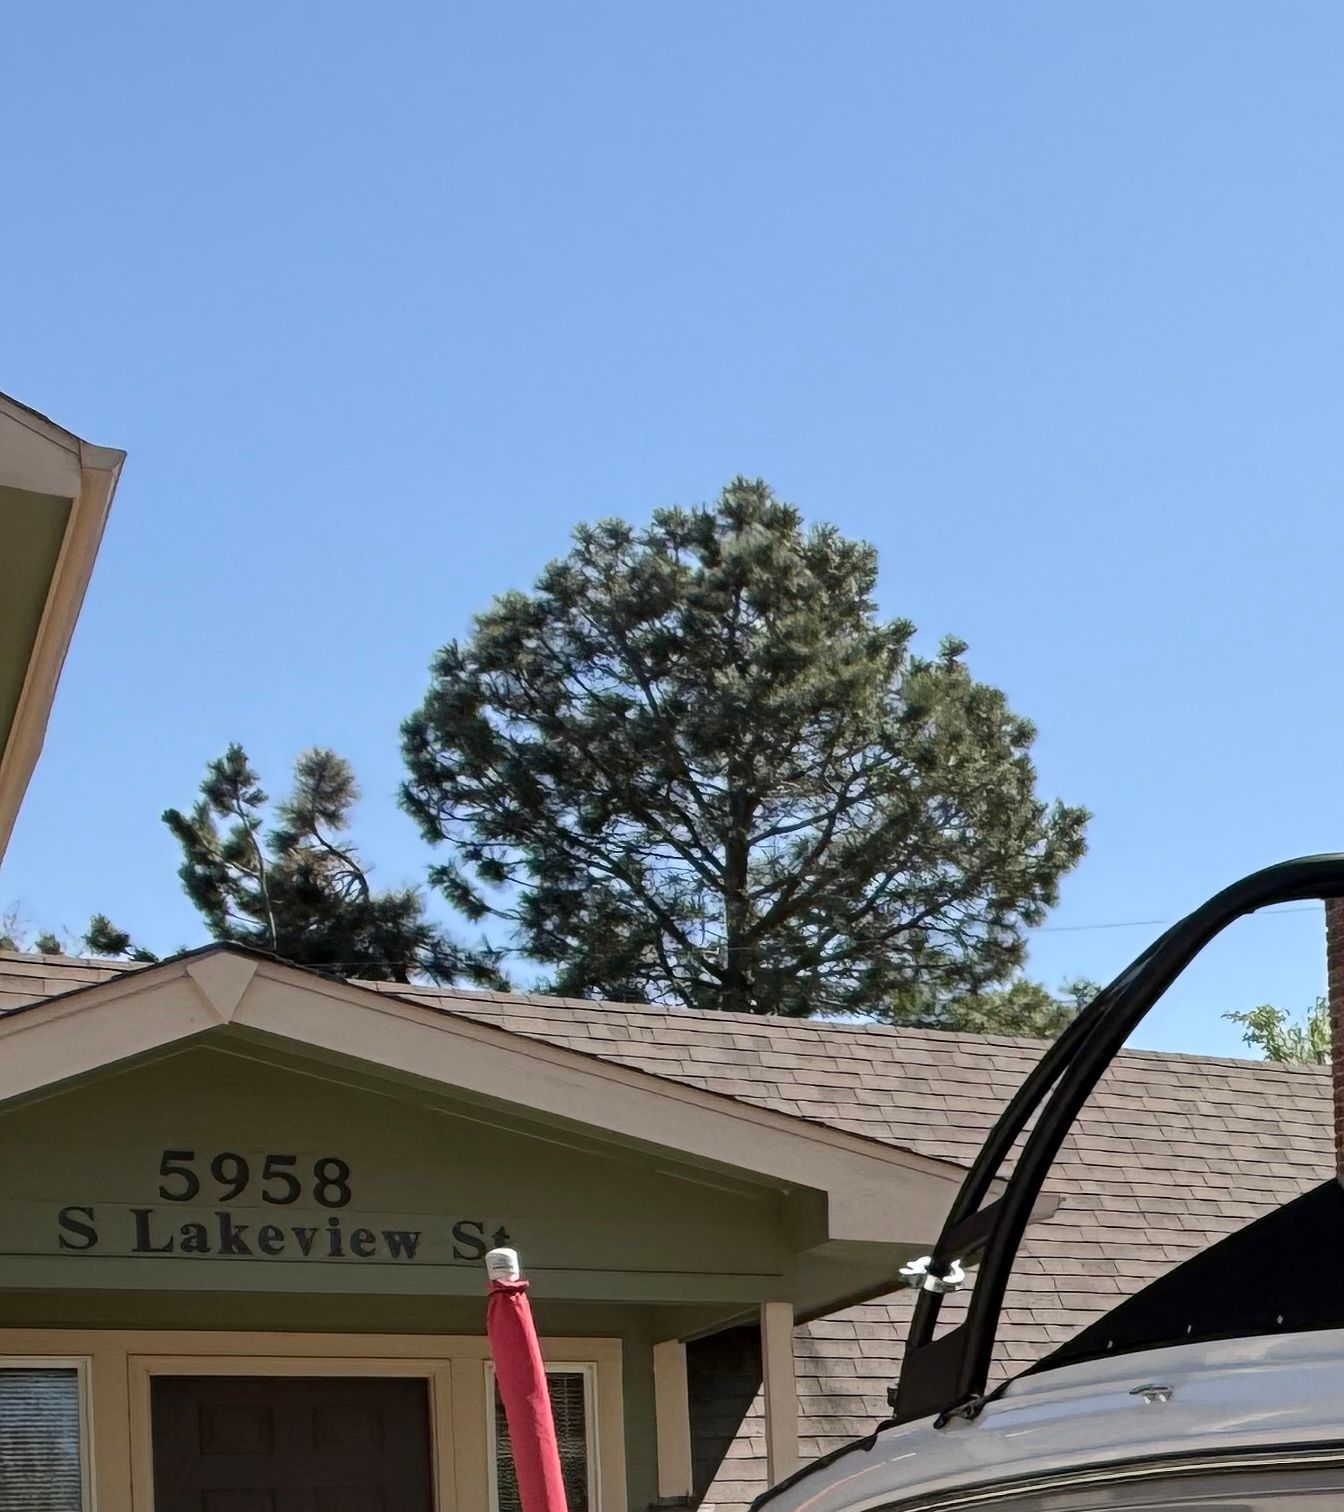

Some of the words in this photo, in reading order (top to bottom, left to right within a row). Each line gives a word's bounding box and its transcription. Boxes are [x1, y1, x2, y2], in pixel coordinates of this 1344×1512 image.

[159, 1150, 351, 1208] 5958
[58, 1206, 98, 1250] S
[129, 1208, 422, 1260] Lakeview
